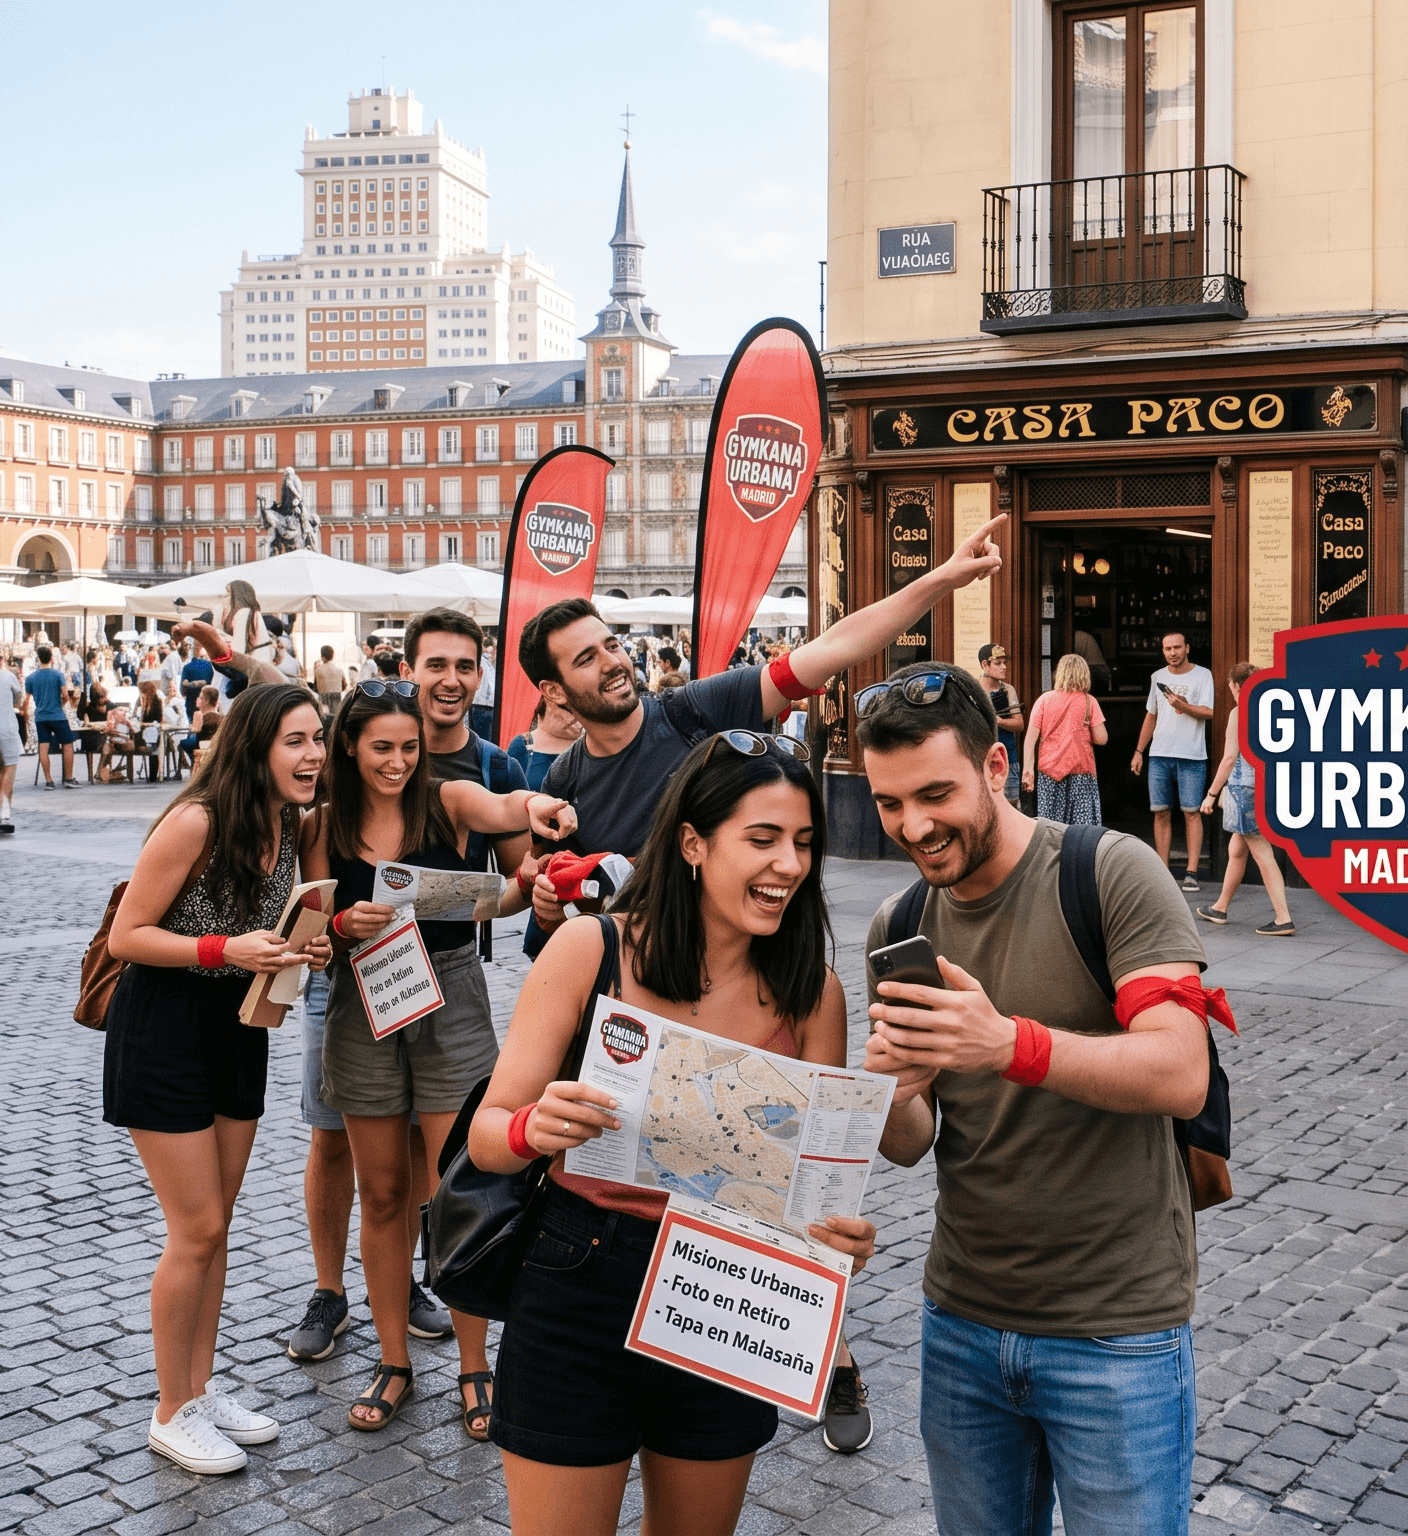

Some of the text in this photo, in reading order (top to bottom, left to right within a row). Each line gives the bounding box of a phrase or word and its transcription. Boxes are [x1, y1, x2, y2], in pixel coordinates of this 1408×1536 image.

[946, 393, 1285, 443] CASA PACO
[727, 434, 803, 468] GYMKANA
[729, 459, 793, 491] URBANA
[528, 514, 591, 541] GYMKANA
[893, 525, 928, 541] Casa
[1322, 513, 1364, 531] Casa
[531, 531, 584, 556] URBANA
[1322, 541, 1364, 560] Paco
[672, 1239, 824, 1308] Misiones Urbanas:
[671, 1274, 709, 1302] Foto
[713, 1293, 734, 1311] en
[737, 1297, 791, 1331] Retiro
[665, 1305, 704, 1335] Tapa
[707, 1325, 729, 1344] en
[732, 1331, 814, 1376] Malasaña
